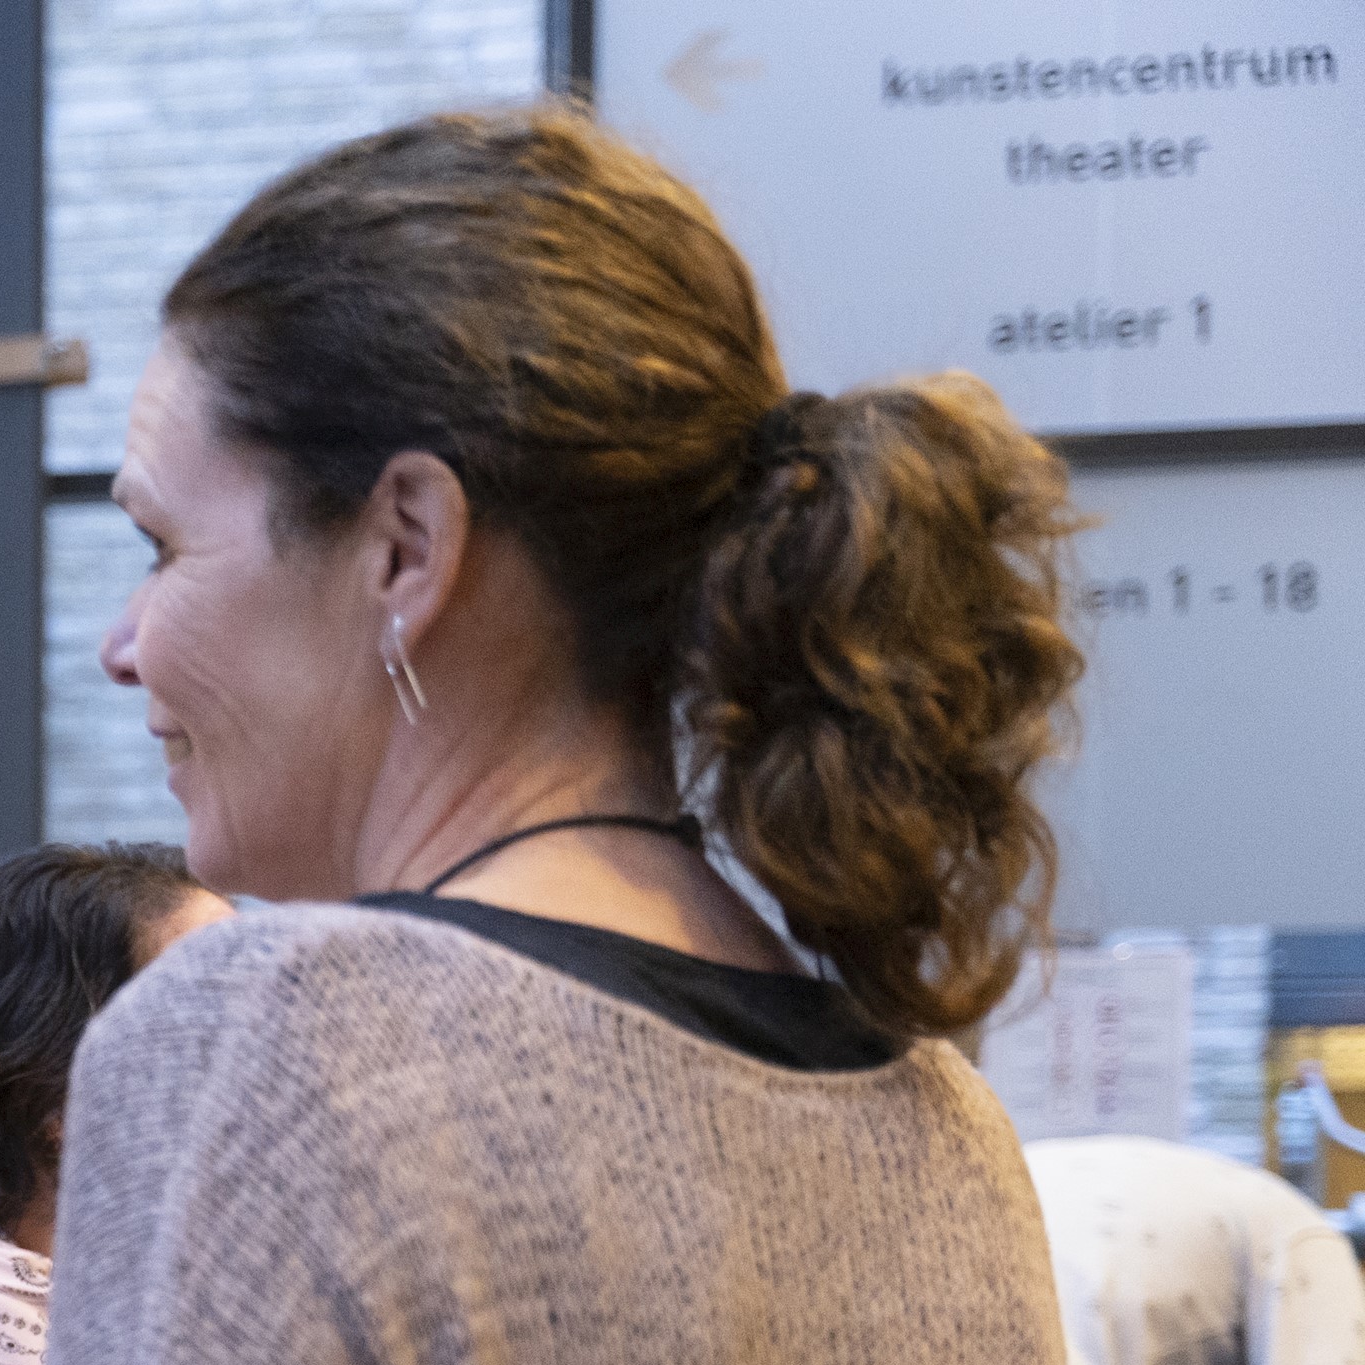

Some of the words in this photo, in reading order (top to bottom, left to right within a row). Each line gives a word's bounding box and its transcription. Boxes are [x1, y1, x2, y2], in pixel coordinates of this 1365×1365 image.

[881, 43, 1338, 103] kunstencentrum
[1006, 135, 1207, 184] theater
[987, 299, 1174, 353] atelier
[1191, 297, 1212, 345] 1
[1081, 578, 1149, 615] en
[1170, 566, 1191, 613] 1
[1258, 561, 1319, 612] 18
